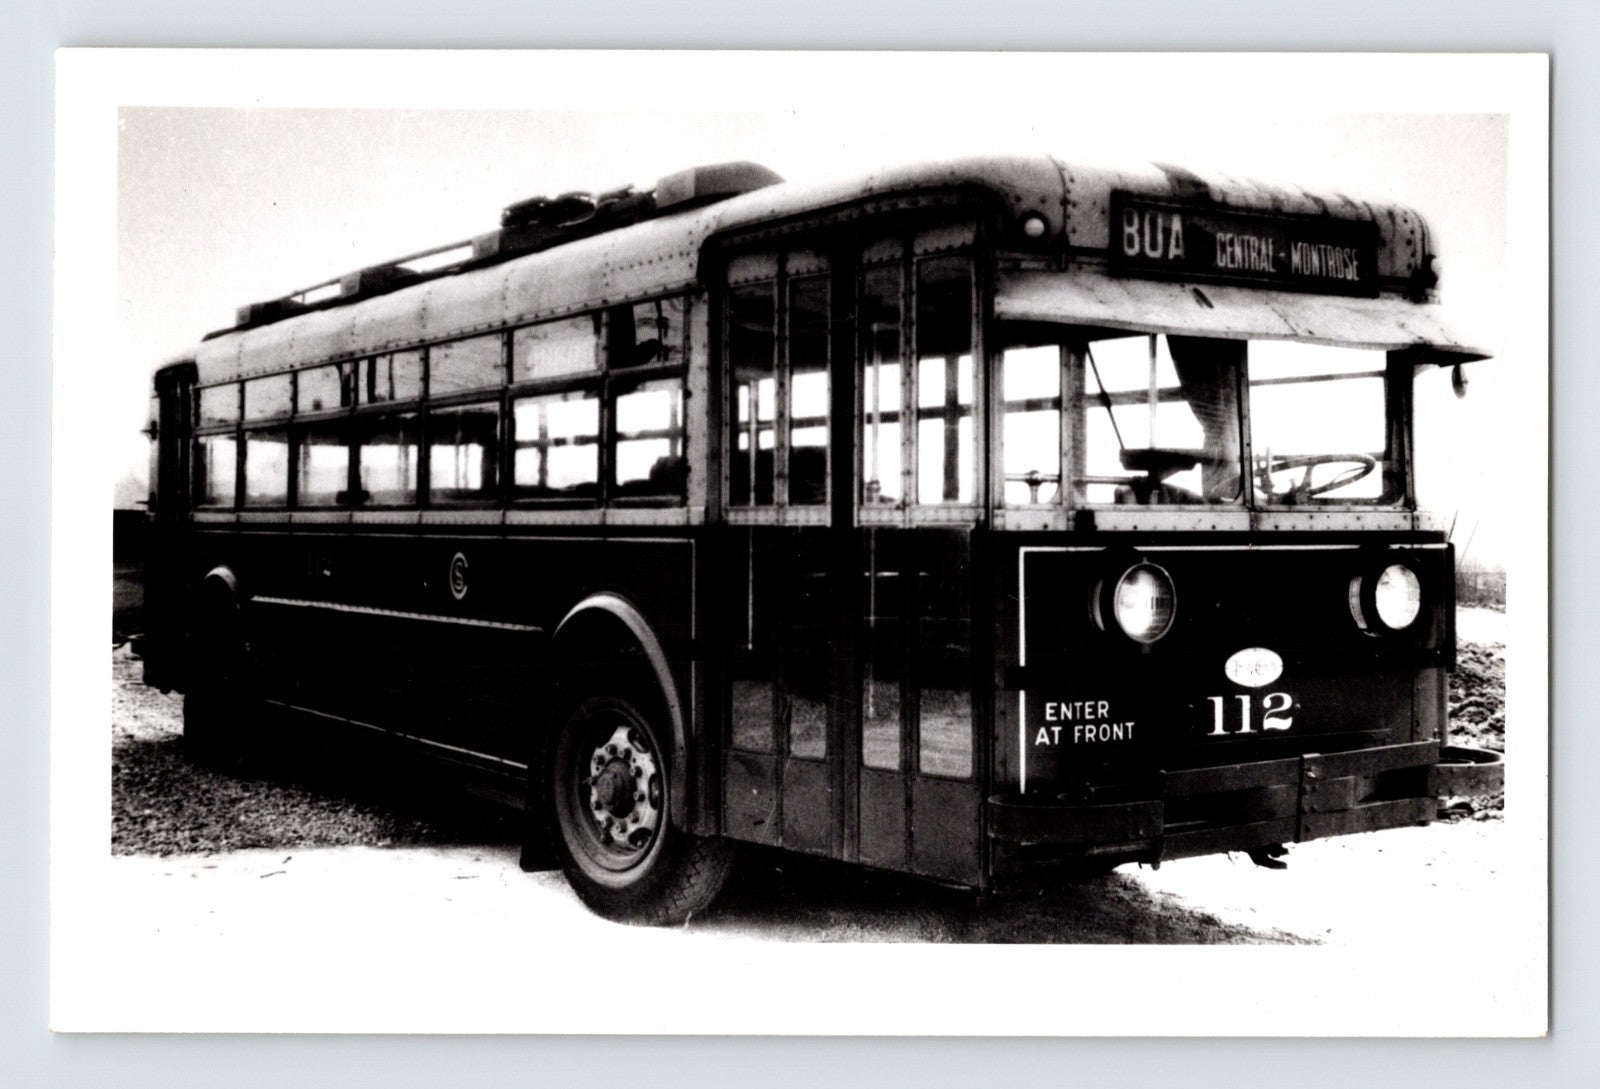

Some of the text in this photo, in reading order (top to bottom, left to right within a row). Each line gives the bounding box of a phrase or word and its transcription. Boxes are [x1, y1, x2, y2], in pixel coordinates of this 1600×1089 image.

[1215, 232, 1277, 273] CENTRAL
[1290, 241, 1360, 282] MONTROSE
[1045, 700, 1110, 721] ENTER
[1207, 691, 1294, 736] 112
[1034, 721, 1135, 746] AT FRONT
